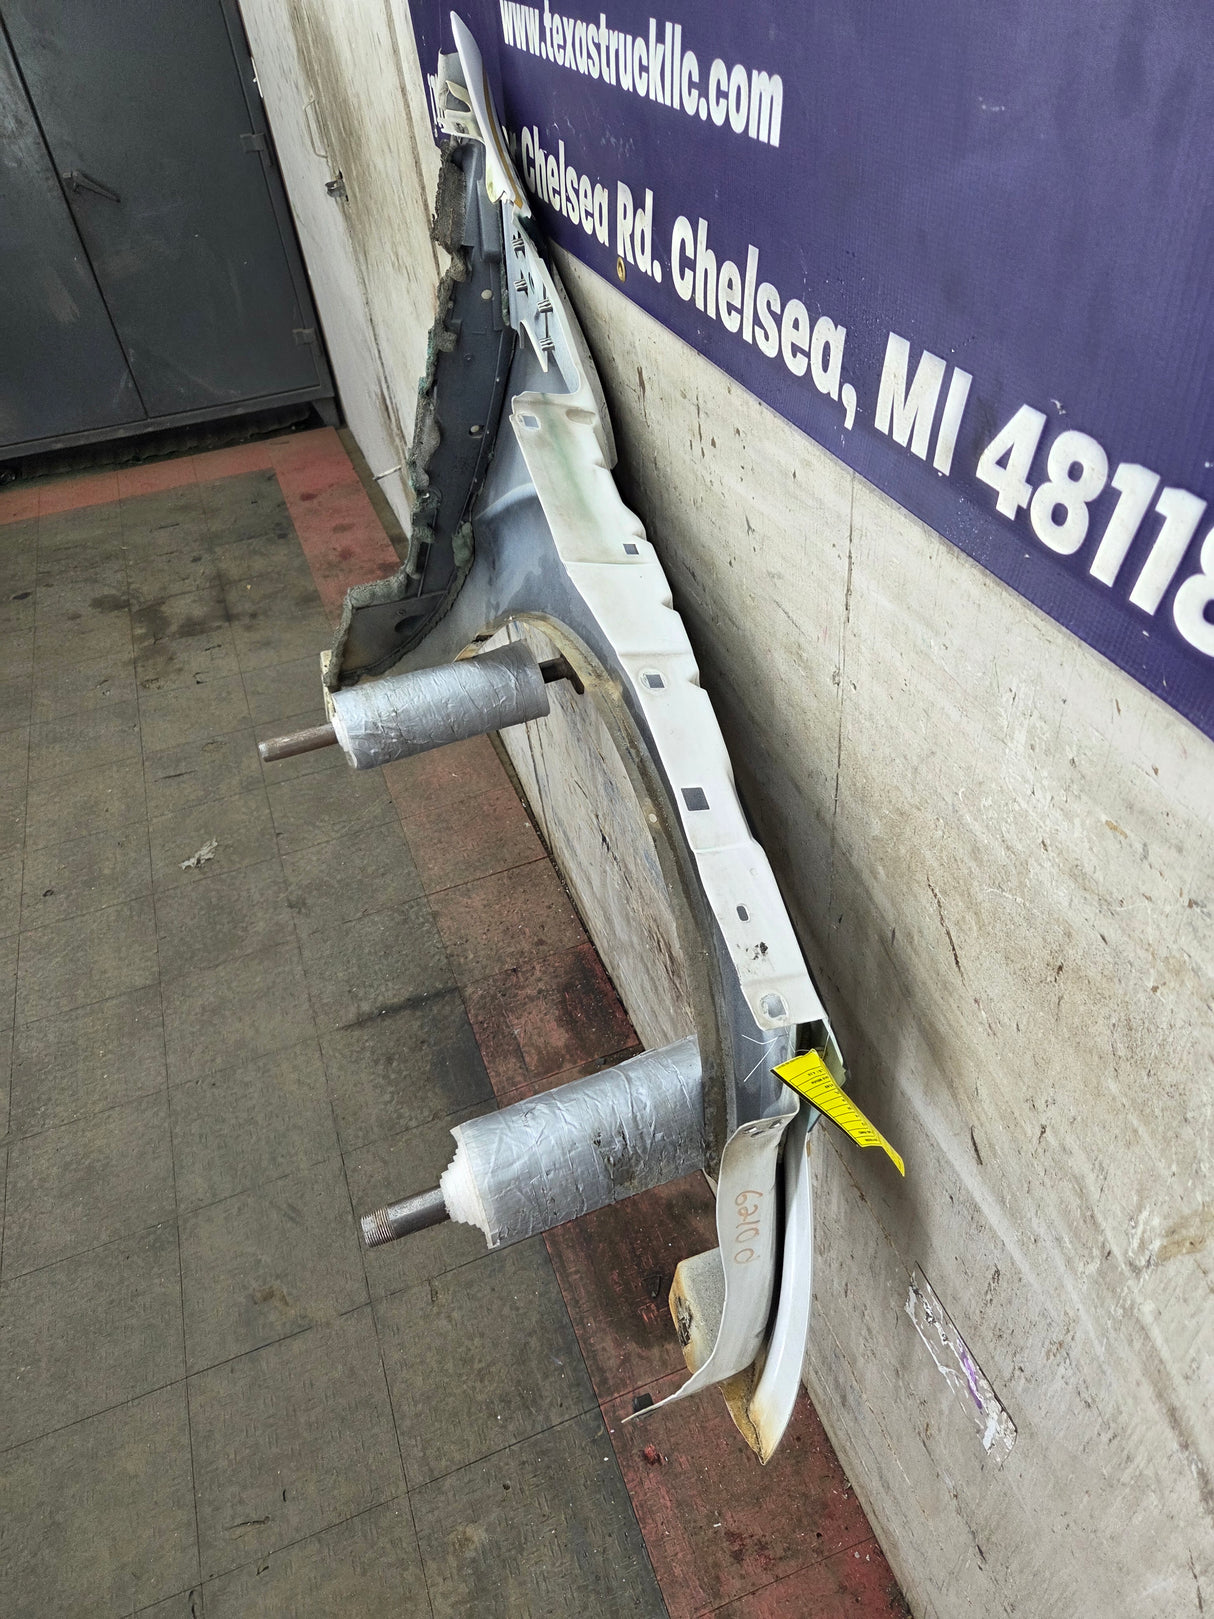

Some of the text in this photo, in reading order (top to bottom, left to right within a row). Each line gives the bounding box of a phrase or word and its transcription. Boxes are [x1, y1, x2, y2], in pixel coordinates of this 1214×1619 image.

[499, 0, 784, 148] www.texastruckllc.com
[521, 126, 609, 248] Chelsea
[617, 180, 662, 283] Rd.
[671, 215, 858, 431] Chelsea,
[874, 331, 973, 477] MI
